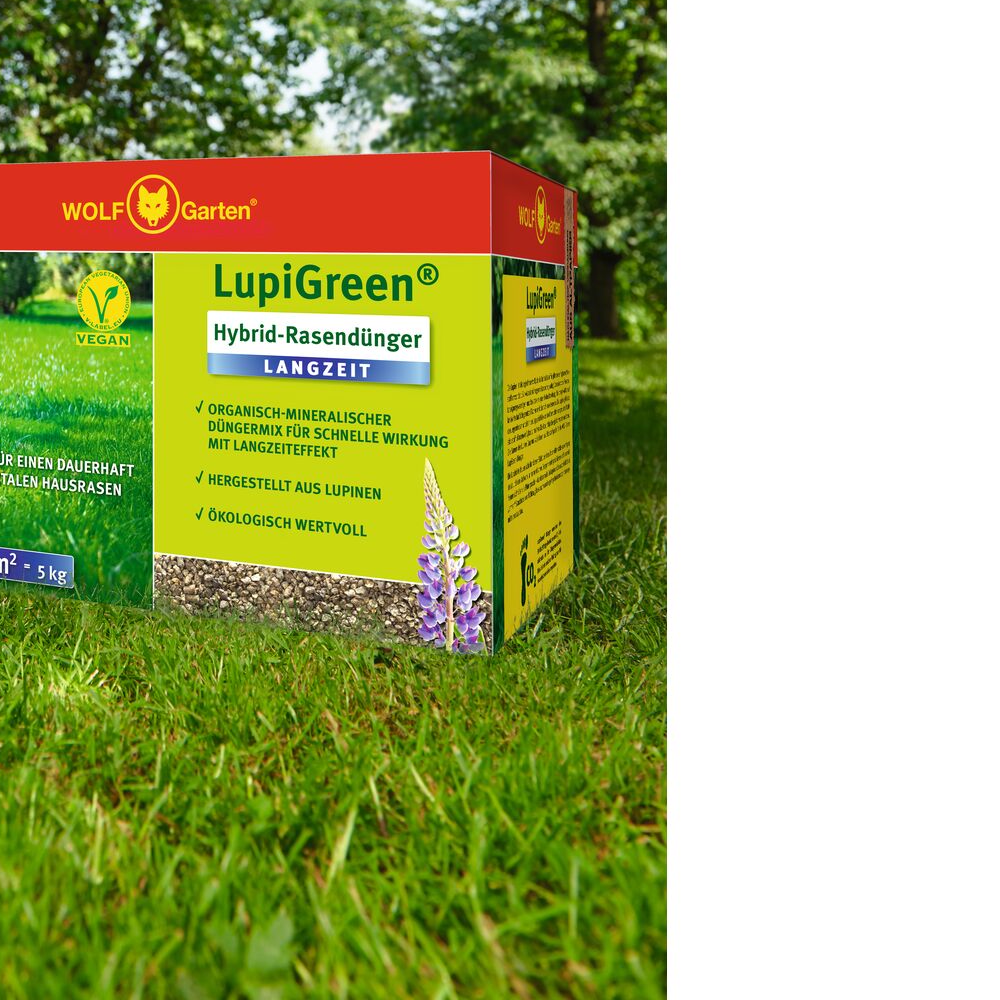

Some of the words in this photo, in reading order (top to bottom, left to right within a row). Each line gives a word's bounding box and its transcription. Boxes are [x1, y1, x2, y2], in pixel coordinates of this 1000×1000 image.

[62, 202, 124, 221] WOLF
[518, 205, 535, 228] WOLF
[77, 277, 91, 313] EUROPEAN
[91, 271, 126, 290] VEGETARIAN
[215, 262, 439, 308] LupiGreen®
[77, 334, 129, 346] VEGAN
[214, 323, 422, 352] Hybrid-Rasendünger
[264, 359, 371, 378] LANGZEIT
[208, 403, 392, 426] ORGANISCH-MINERALISCHER
[208, 420, 283, 437] DÜNGERMIX
[286, 424, 310, 439] FÜR
[313, 427, 379, 444] SCHNELLE
[382, 432, 449, 449] WIRKUNG
[208, 438, 231, 450] MIT
[233, 439, 338, 458] LANGZEITEFFEKT
[17, 455, 53, 470] EINEN
[57, 459, 134, 477] DAUERHAFT
[42, 477, 122, 496] HAUSRASEN
[208, 474, 292, 492] HERGESTELLT
[295, 481, 321, 495] AUS
[325, 483, 382, 500] LUPINEN
[208, 508, 292, 529] ÖKOLOGISCH
[295, 518, 367, 537] WERTVOLL
[37, 565, 45, 579] 5
[49, 566, 68, 584] kg
